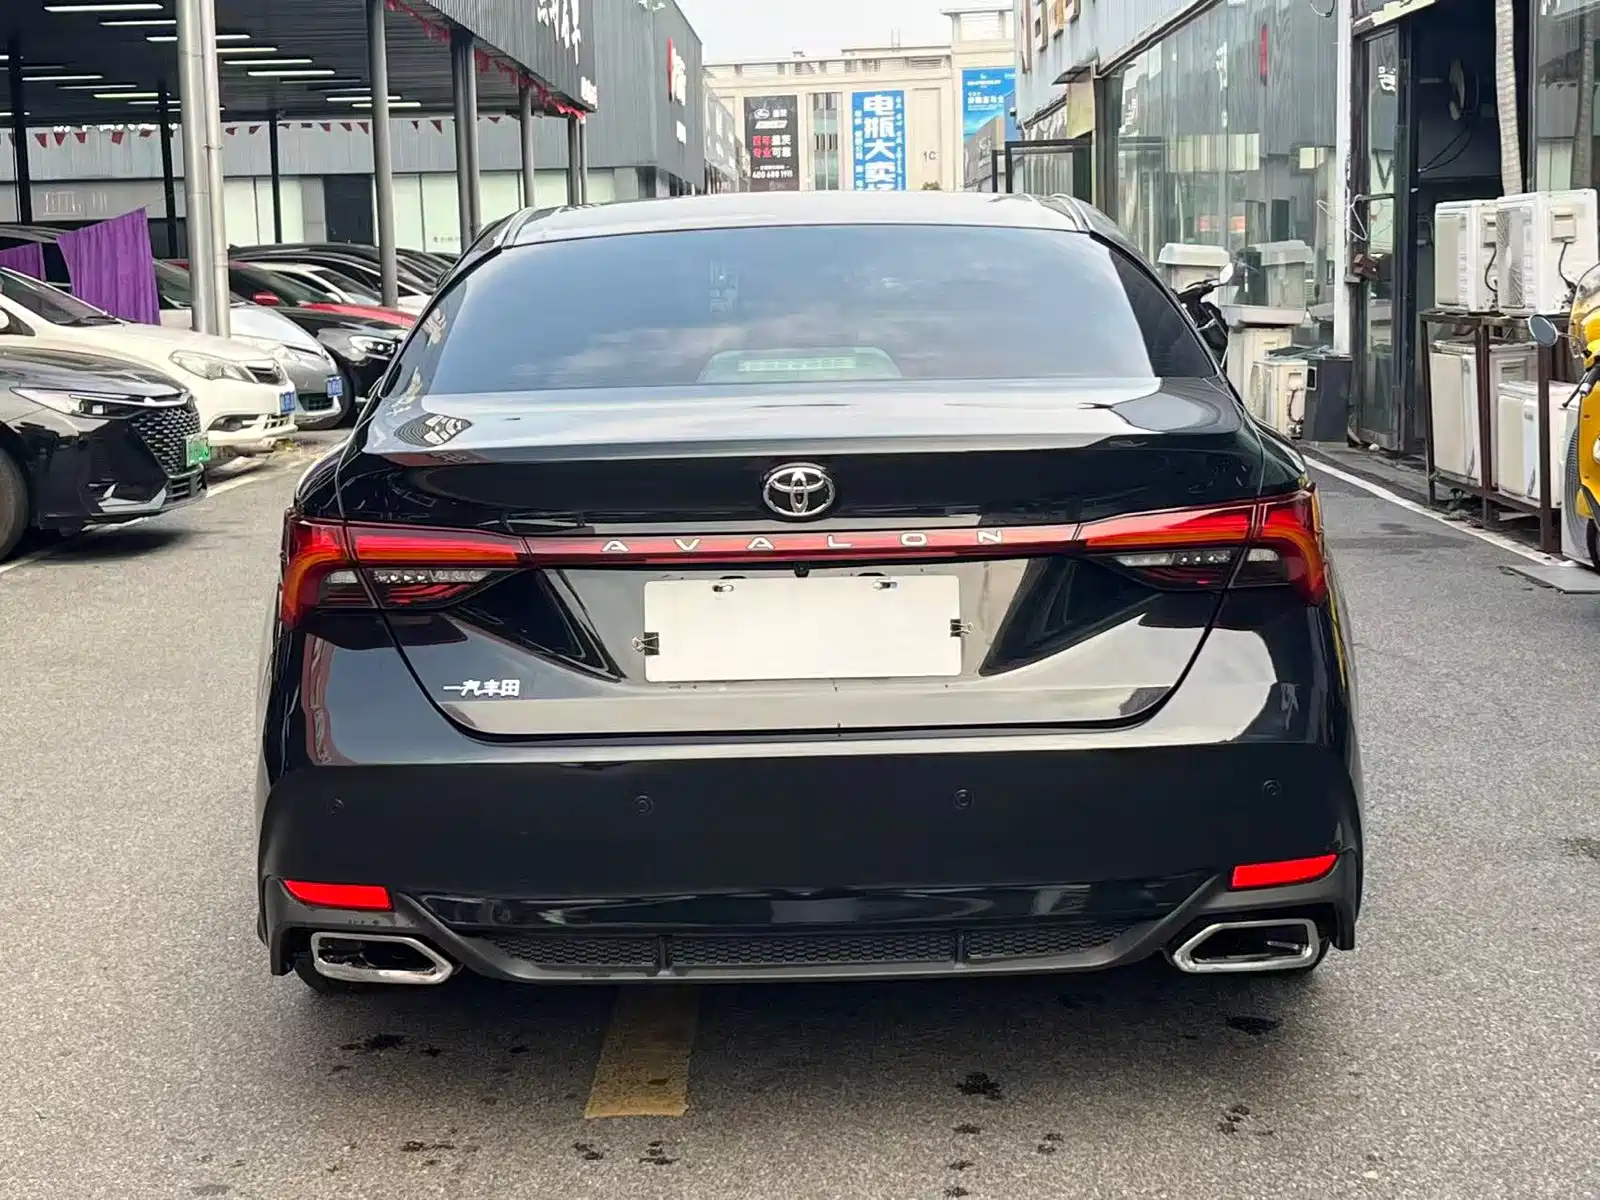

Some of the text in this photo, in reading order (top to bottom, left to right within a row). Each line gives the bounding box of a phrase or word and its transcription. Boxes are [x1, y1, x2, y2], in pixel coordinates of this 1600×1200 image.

[601, 530, 1006, 553] AVALON
[443, 679, 520, 697] 一汽丰田
